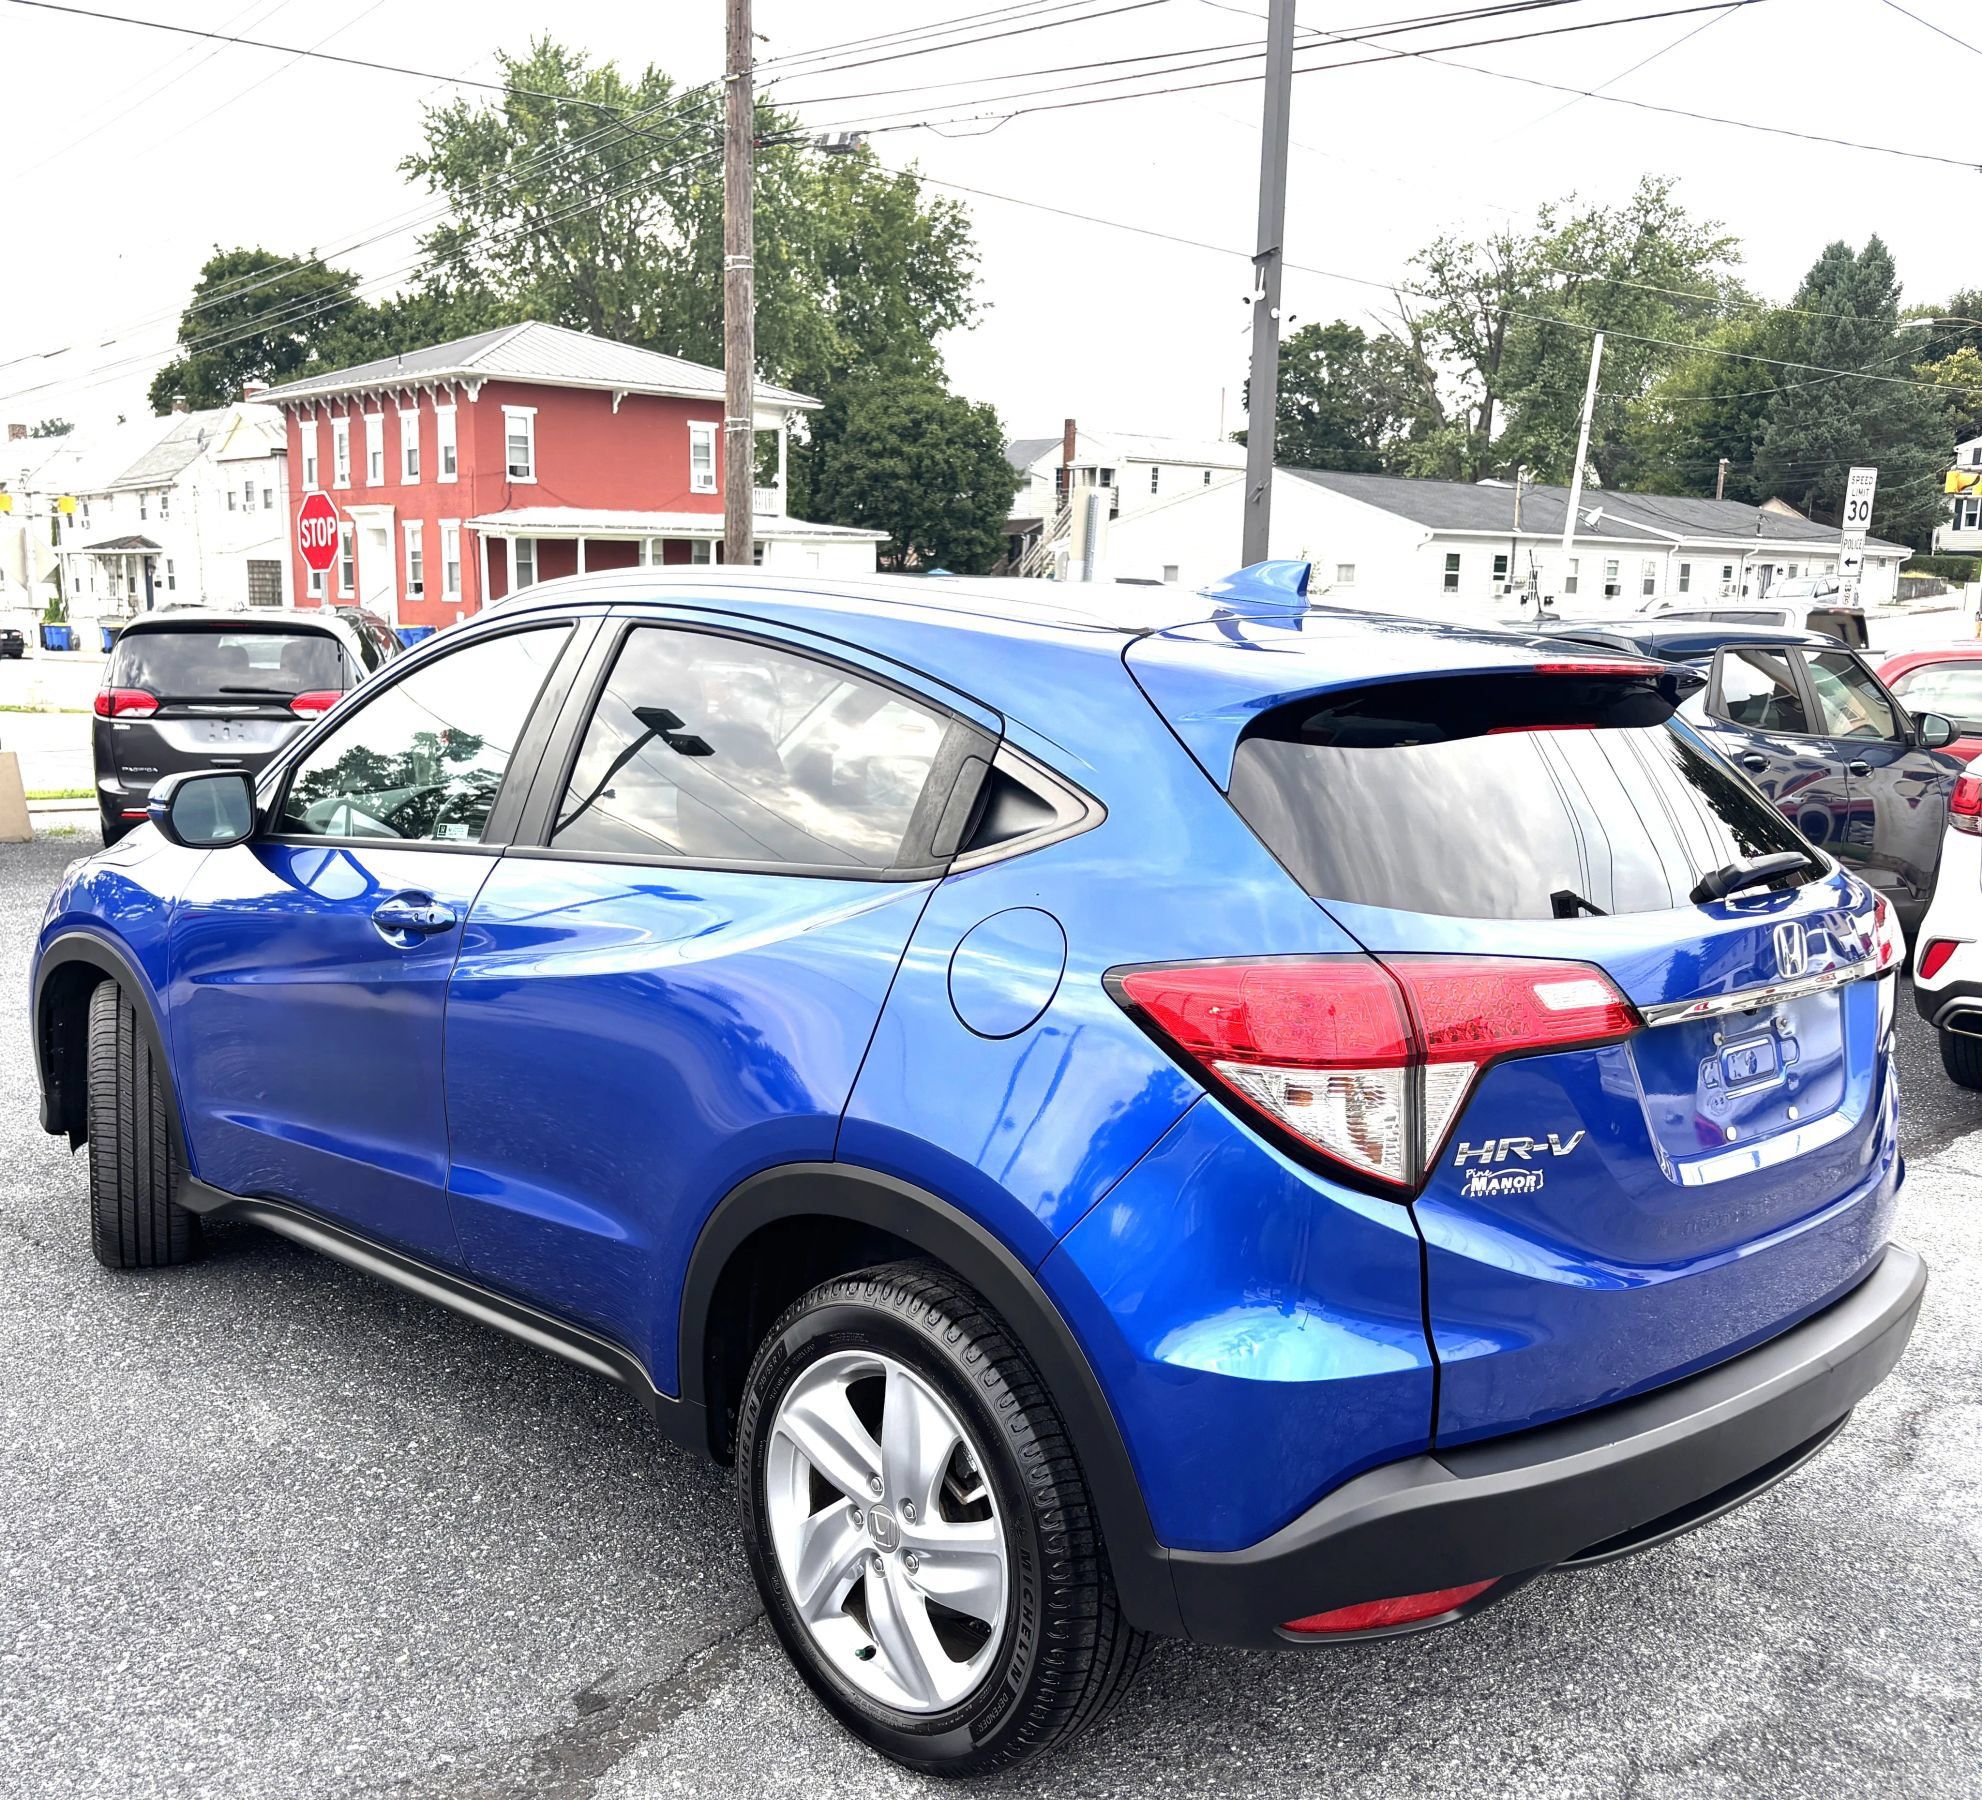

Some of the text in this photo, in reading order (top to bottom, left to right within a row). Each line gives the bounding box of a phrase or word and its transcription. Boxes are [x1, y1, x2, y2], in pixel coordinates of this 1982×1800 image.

[1851, 475, 1873, 485] SPEED
[1851, 488, 1870, 497] LIMIT
[1847, 500, 1869, 521] 30
[301, 516, 336, 548] STOP
[1454, 1130, 1586, 1166] HR-V
[1466, 1168, 1492, 1179] Pine
[1470, 1175, 1537, 1192] MANOR
[1470, 1186, 1535, 1198] AUTO SALES
[741, 1399, 758, 1517] MICHELIN
[1011, 1547, 1033, 1684] MICHELIN
[978, 1692, 1009, 1732] DEFENDER
